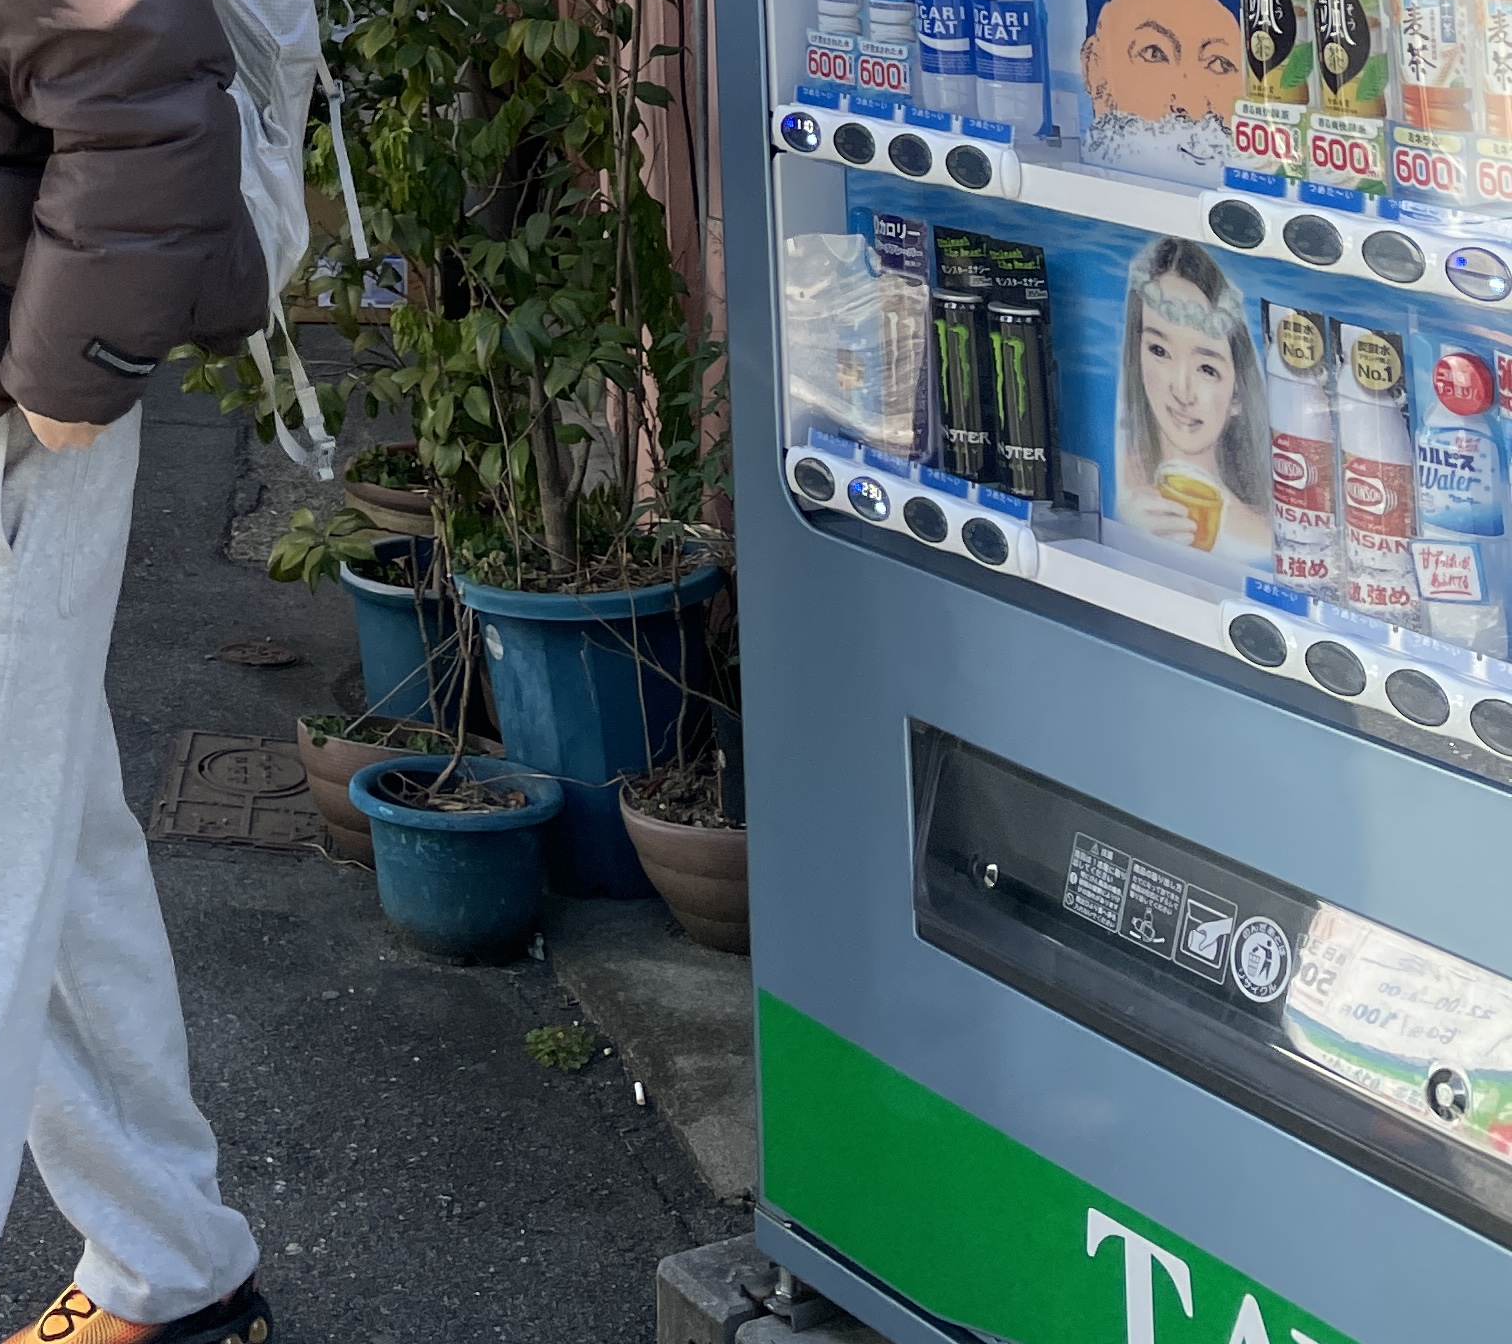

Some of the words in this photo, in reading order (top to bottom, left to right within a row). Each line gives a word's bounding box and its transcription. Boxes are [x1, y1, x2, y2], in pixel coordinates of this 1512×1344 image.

[808, 48, 847, 81] 600
[860, 58, 902, 90] 600
[1235, 121, 1292, 159] 600
[1311, 135, 1369, 180] 600
[1395, 150, 1454, 192] 600
[1358, 363, 1394, 383] No.1
